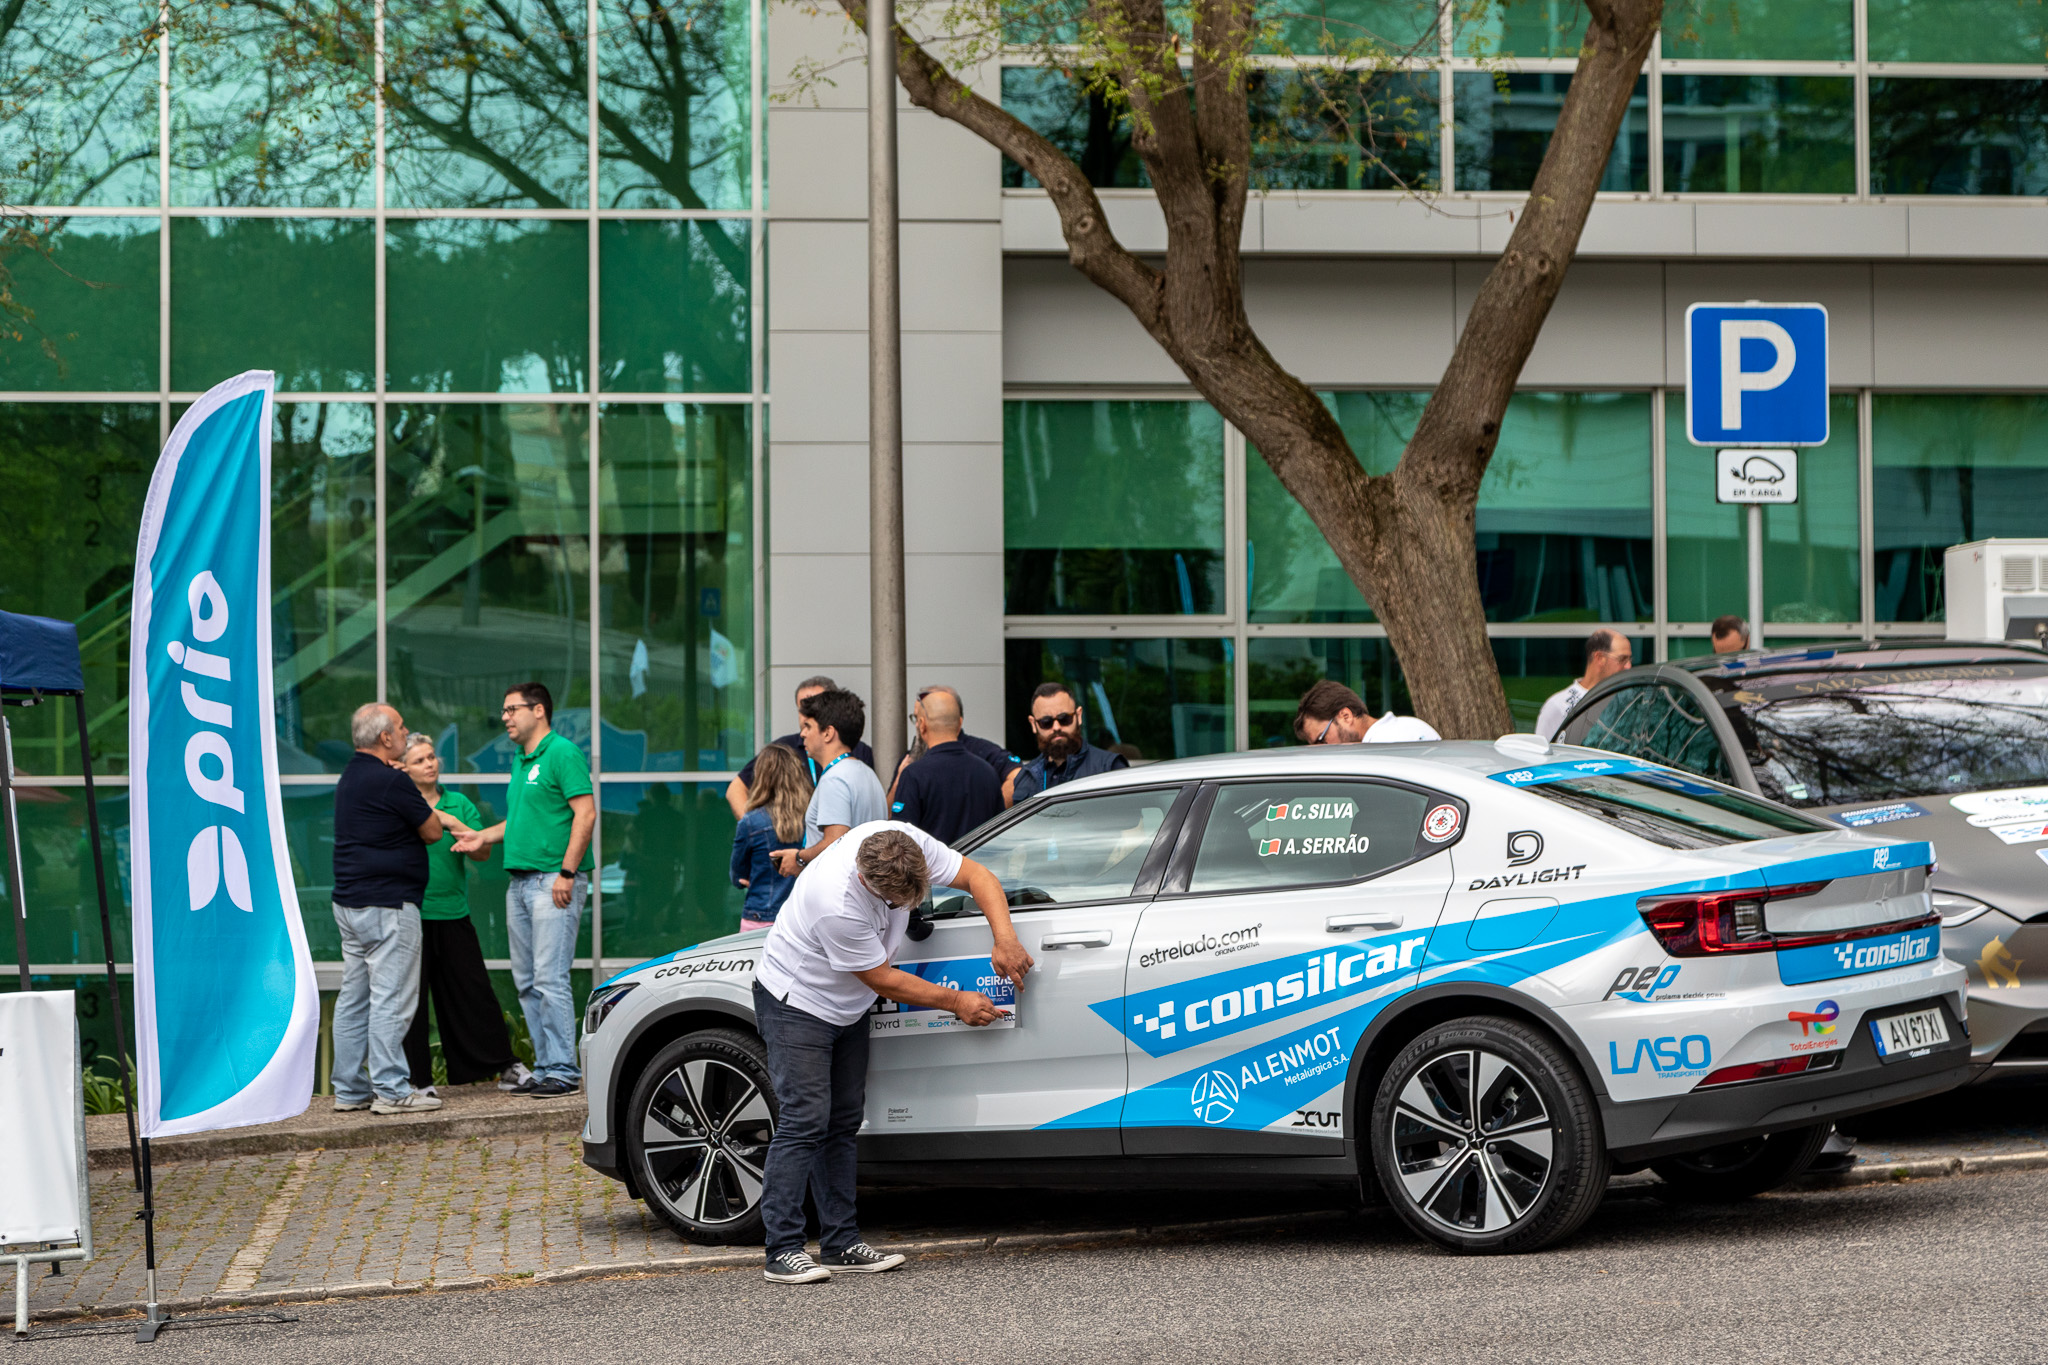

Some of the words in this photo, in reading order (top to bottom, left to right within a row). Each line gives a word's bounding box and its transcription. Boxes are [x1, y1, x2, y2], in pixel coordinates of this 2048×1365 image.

[1720, 319, 1797, 431] P
[166, 569, 246, 815] prio
[1794, 677, 1869, 695] SARA
[1291, 803, 1354, 820] C.SILVA
[1283, 833, 1370, 855] A.SERRÃO
[1873, 847, 1889, 868] pep
[1468, 864, 1587, 891] DAYLIGHT
[1854, 935, 1931, 969] consilcar
[654, 959, 755, 980] coeptum
[1185, 936, 1426, 1033] consilcar
[1602, 965, 1682, 1001] pep
[700, 1042, 762, 1075] MICHELIN
[1241, 1026, 1341, 1090] ALENMOT
[1609, 1034, 1712, 1075] LASO
[1789, 1037, 1838, 1052] TotalEnergies
[1284, 1060, 1333, 1087] Metalúrgica
[1333, 1053, 1350, 1066] S.A.
[1384, 1036, 1437, 1094] MICHELIN
[1657, 1069, 1708, 1079] TRANSPORTES
